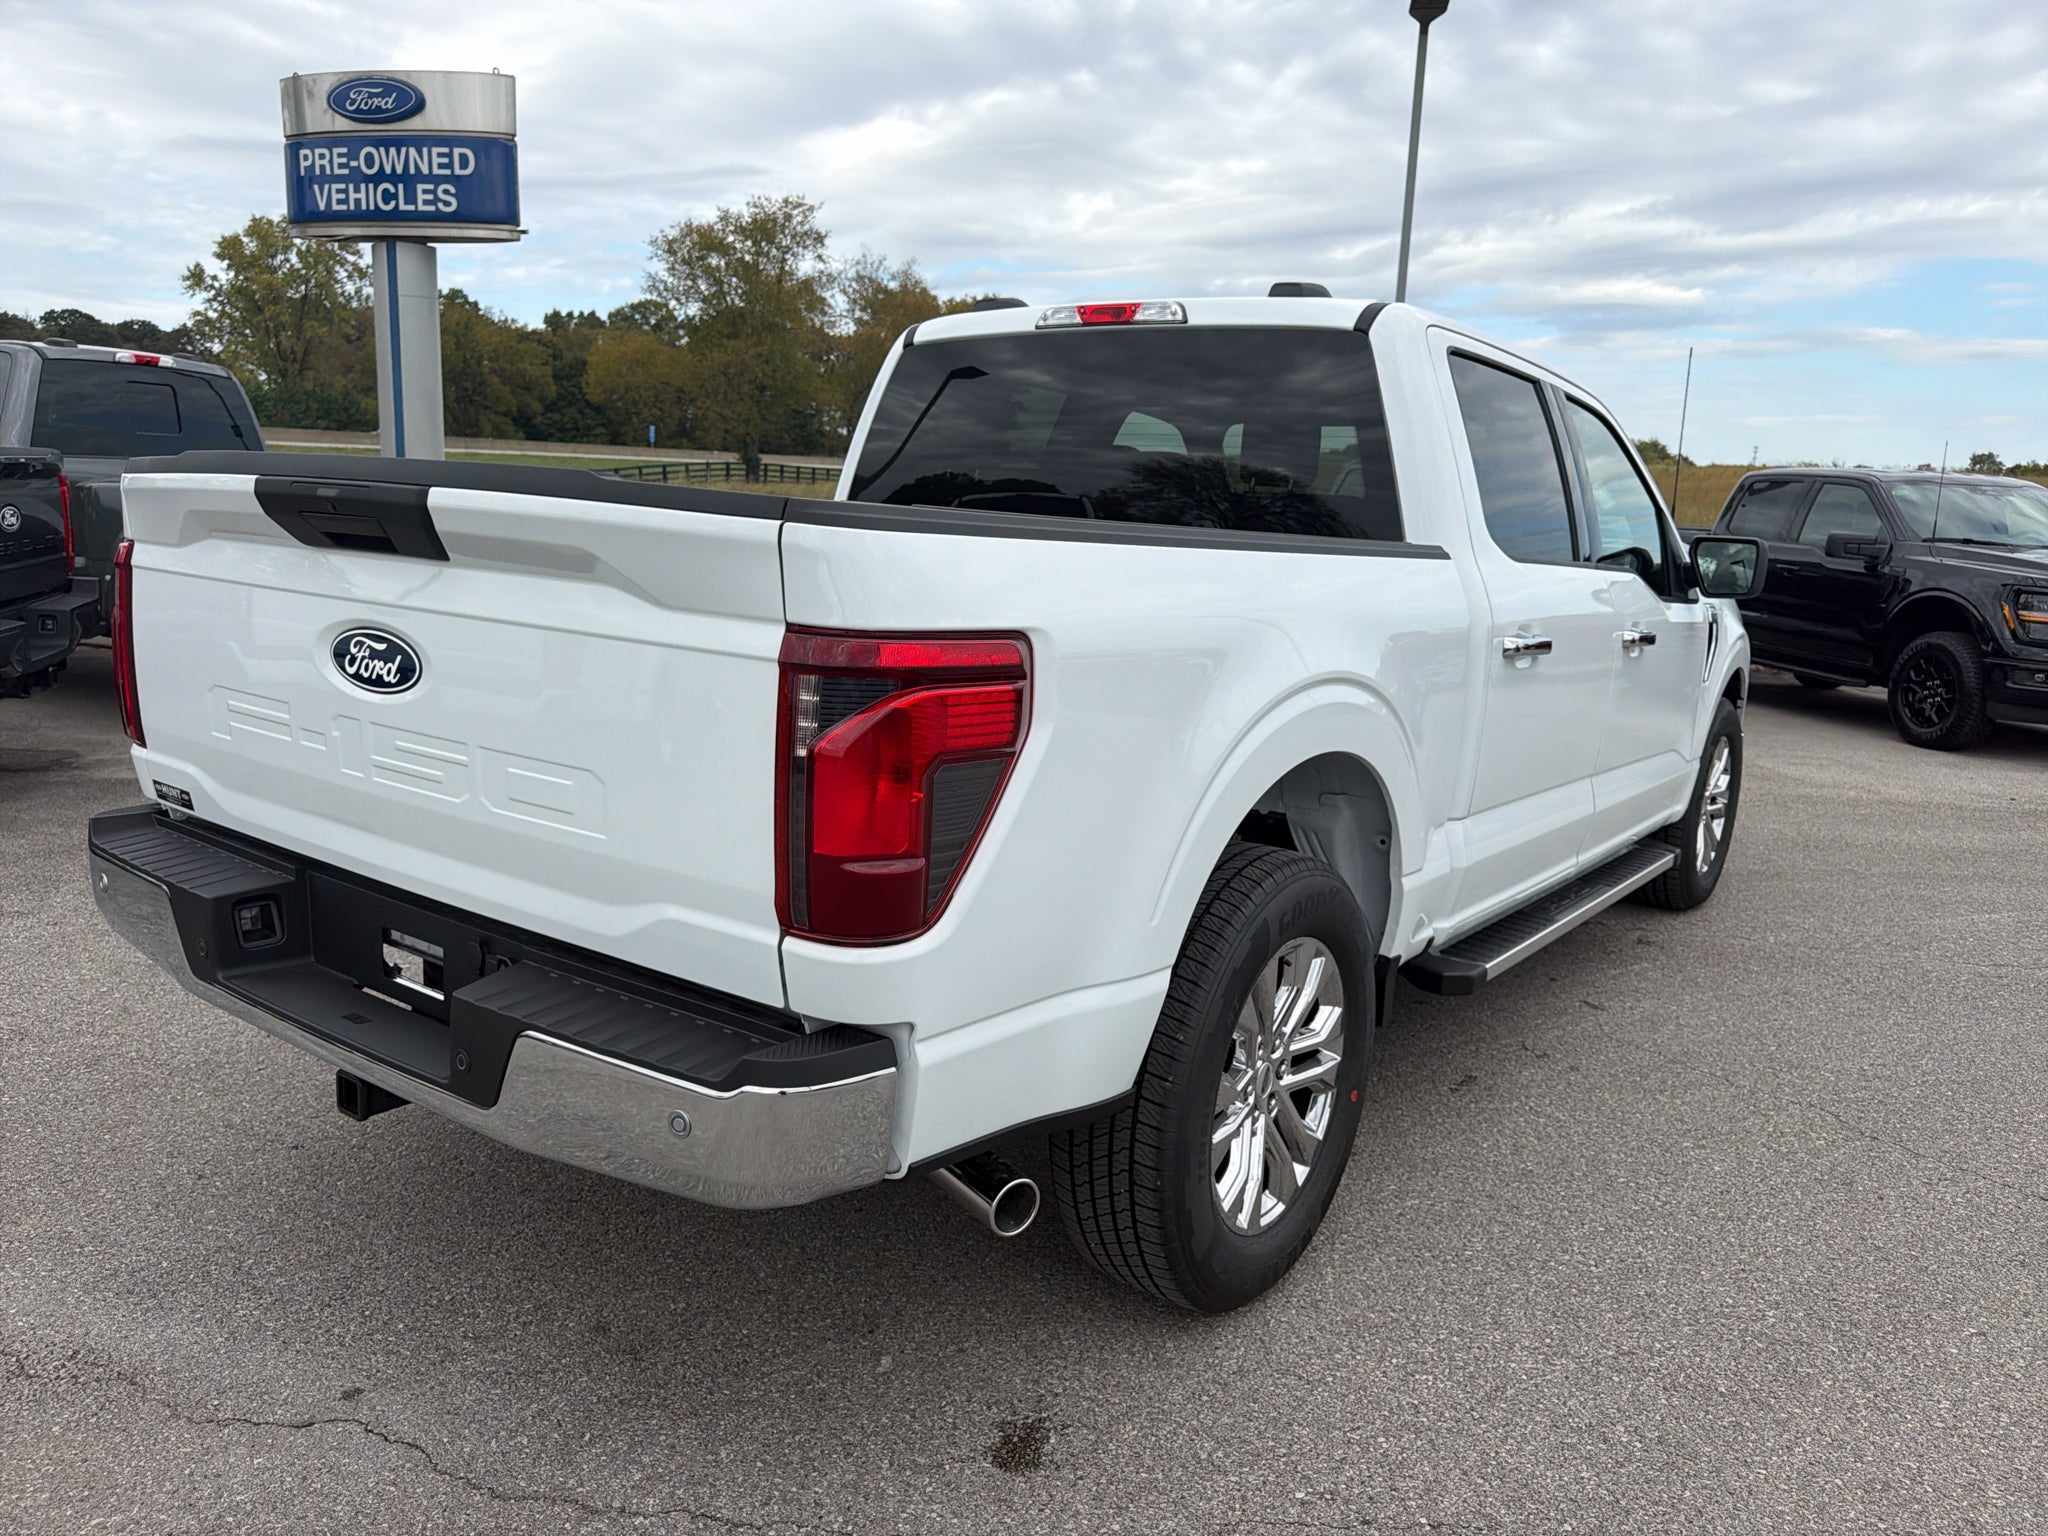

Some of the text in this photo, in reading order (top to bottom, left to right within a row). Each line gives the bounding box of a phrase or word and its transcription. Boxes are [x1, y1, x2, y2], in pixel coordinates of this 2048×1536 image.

[346, 87, 397, 110] Ford
[299, 146, 475, 177] PRE-OWNED
[313, 182, 458, 213] VEHICLES
[344, 636, 402, 684] Ford
[208, 684, 608, 840] F-150
